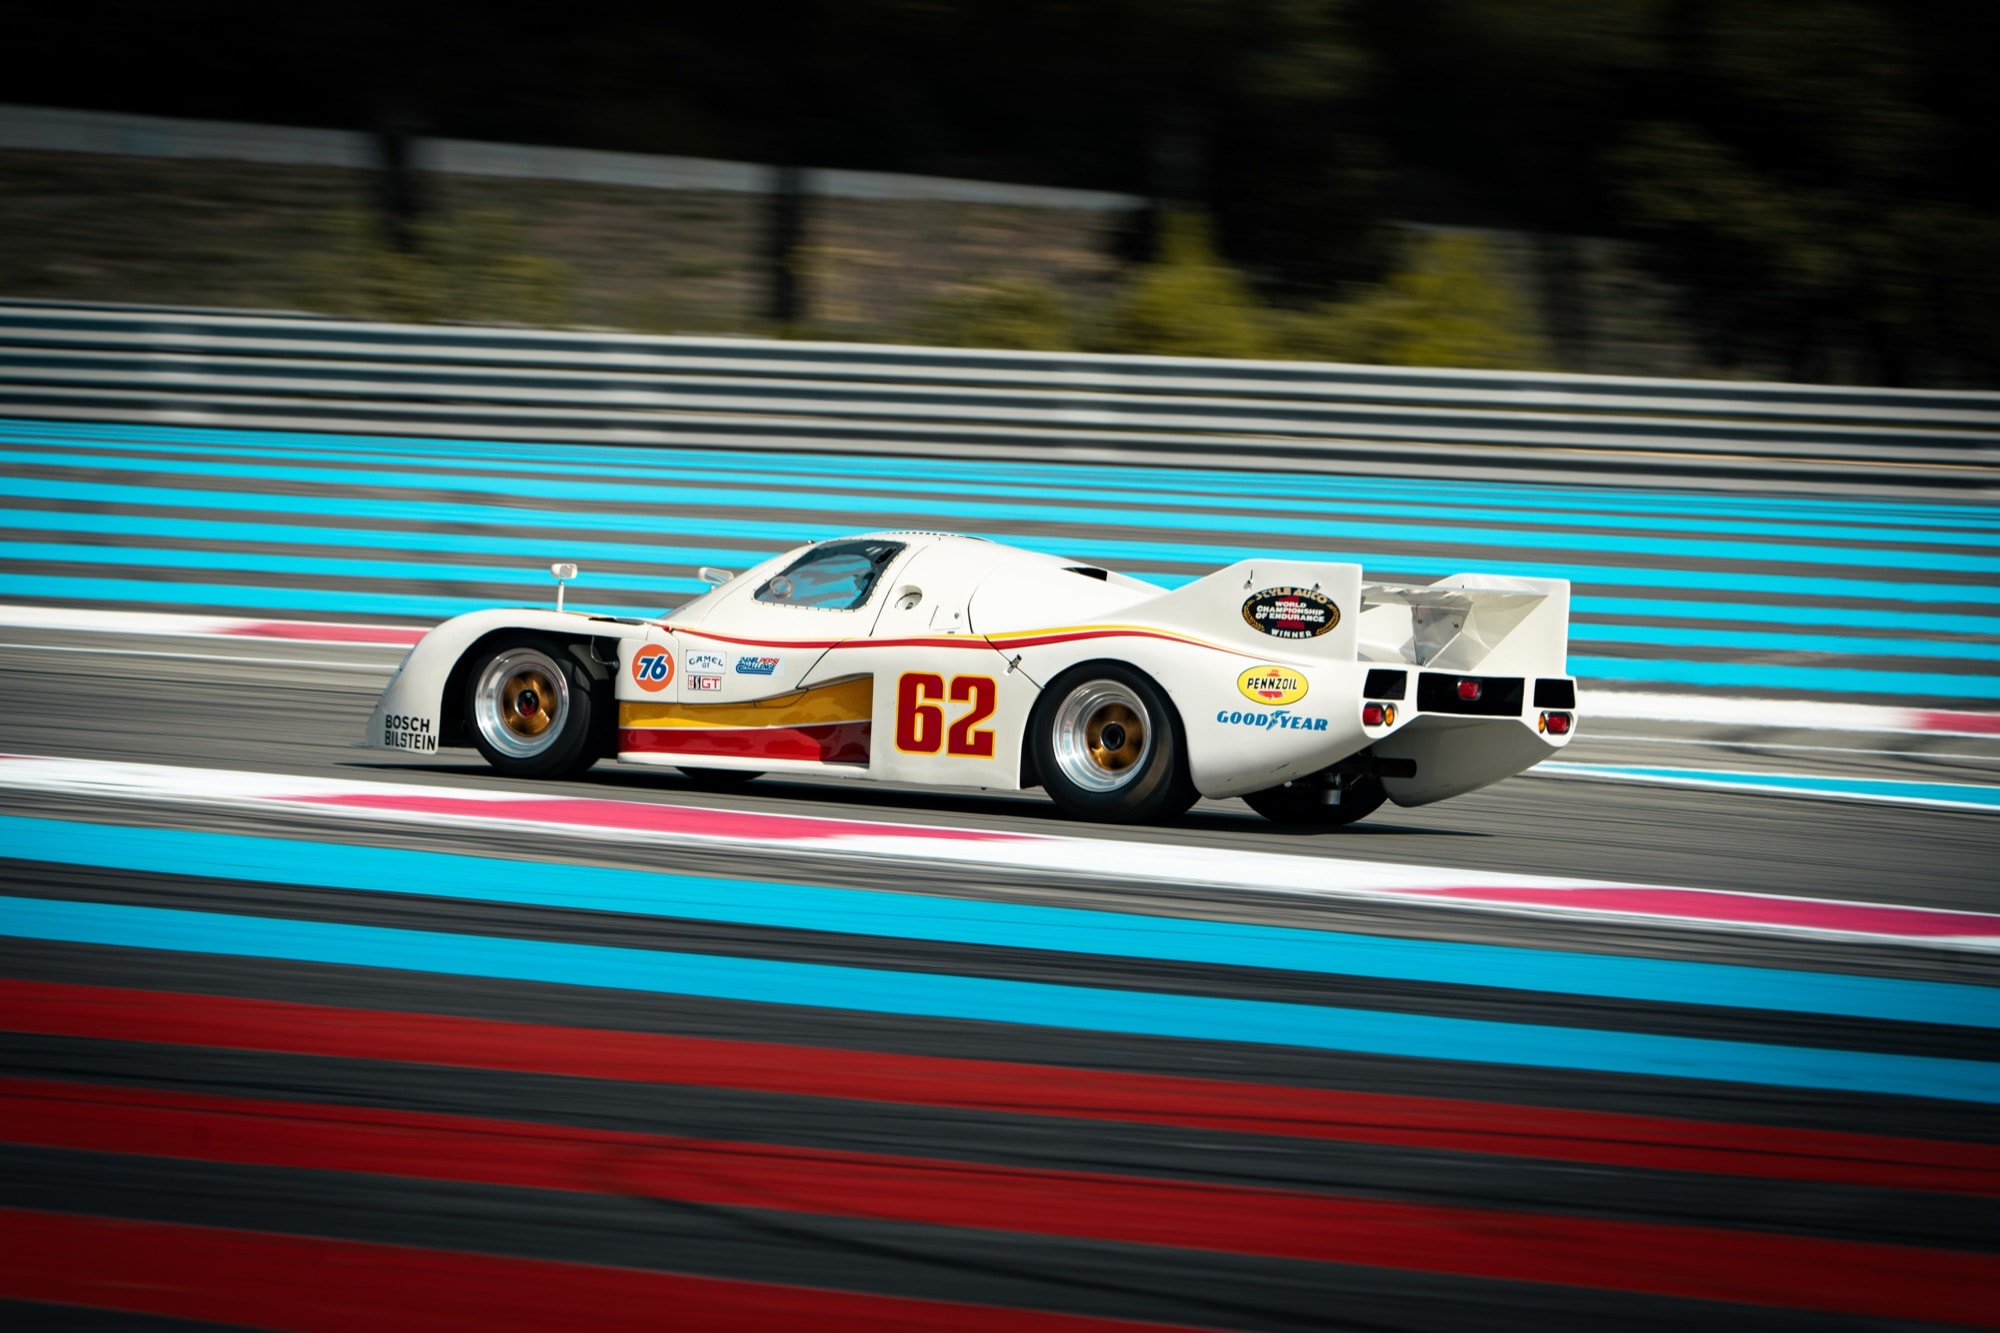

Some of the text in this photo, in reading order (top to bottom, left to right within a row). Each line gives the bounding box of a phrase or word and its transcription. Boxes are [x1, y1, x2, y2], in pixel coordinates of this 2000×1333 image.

[1255, 612, 1325, 622] OF ENDURANCE
[1256, 605, 1325, 616] CHAMPIONSHIP
[1271, 628, 1312, 638] WINNER
[637, 653, 668, 682] 76
[688, 655, 724, 667] CAMEL
[701, 677, 720, 689] GT
[1246, 677, 1298, 690] PENNZOIL
[894, 670, 999, 759] 62
[1216, 709, 1328, 731] GOODYEAR
[385, 714, 430, 733] BOSCH
[385, 730, 436, 751] BILSTEIN
